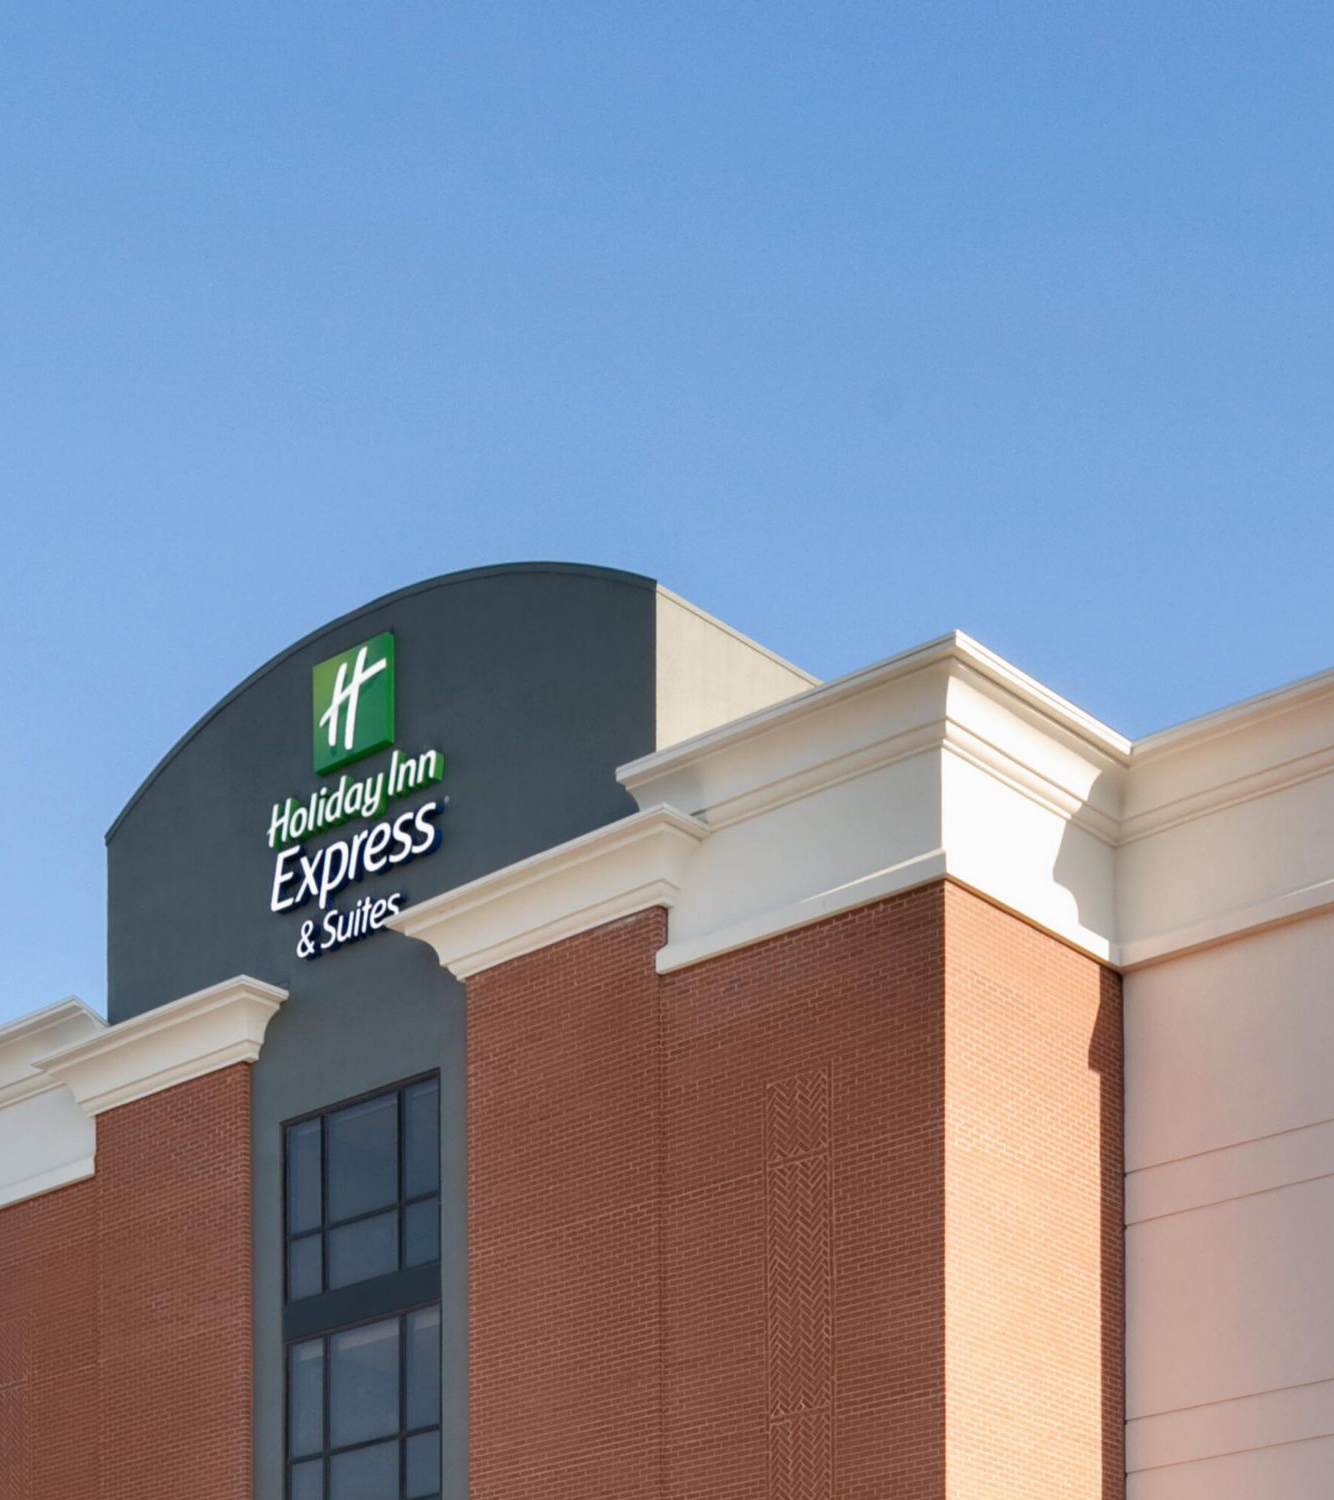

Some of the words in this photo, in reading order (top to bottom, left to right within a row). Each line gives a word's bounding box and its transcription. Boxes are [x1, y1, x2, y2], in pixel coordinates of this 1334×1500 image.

[319, 646, 387, 750] H
[267, 772, 384, 848] Holiday
[388, 749, 438, 796] Inn
[271, 802, 438, 912] Express
[296, 920, 315, 958] &
[321, 893, 401, 949] Suites
